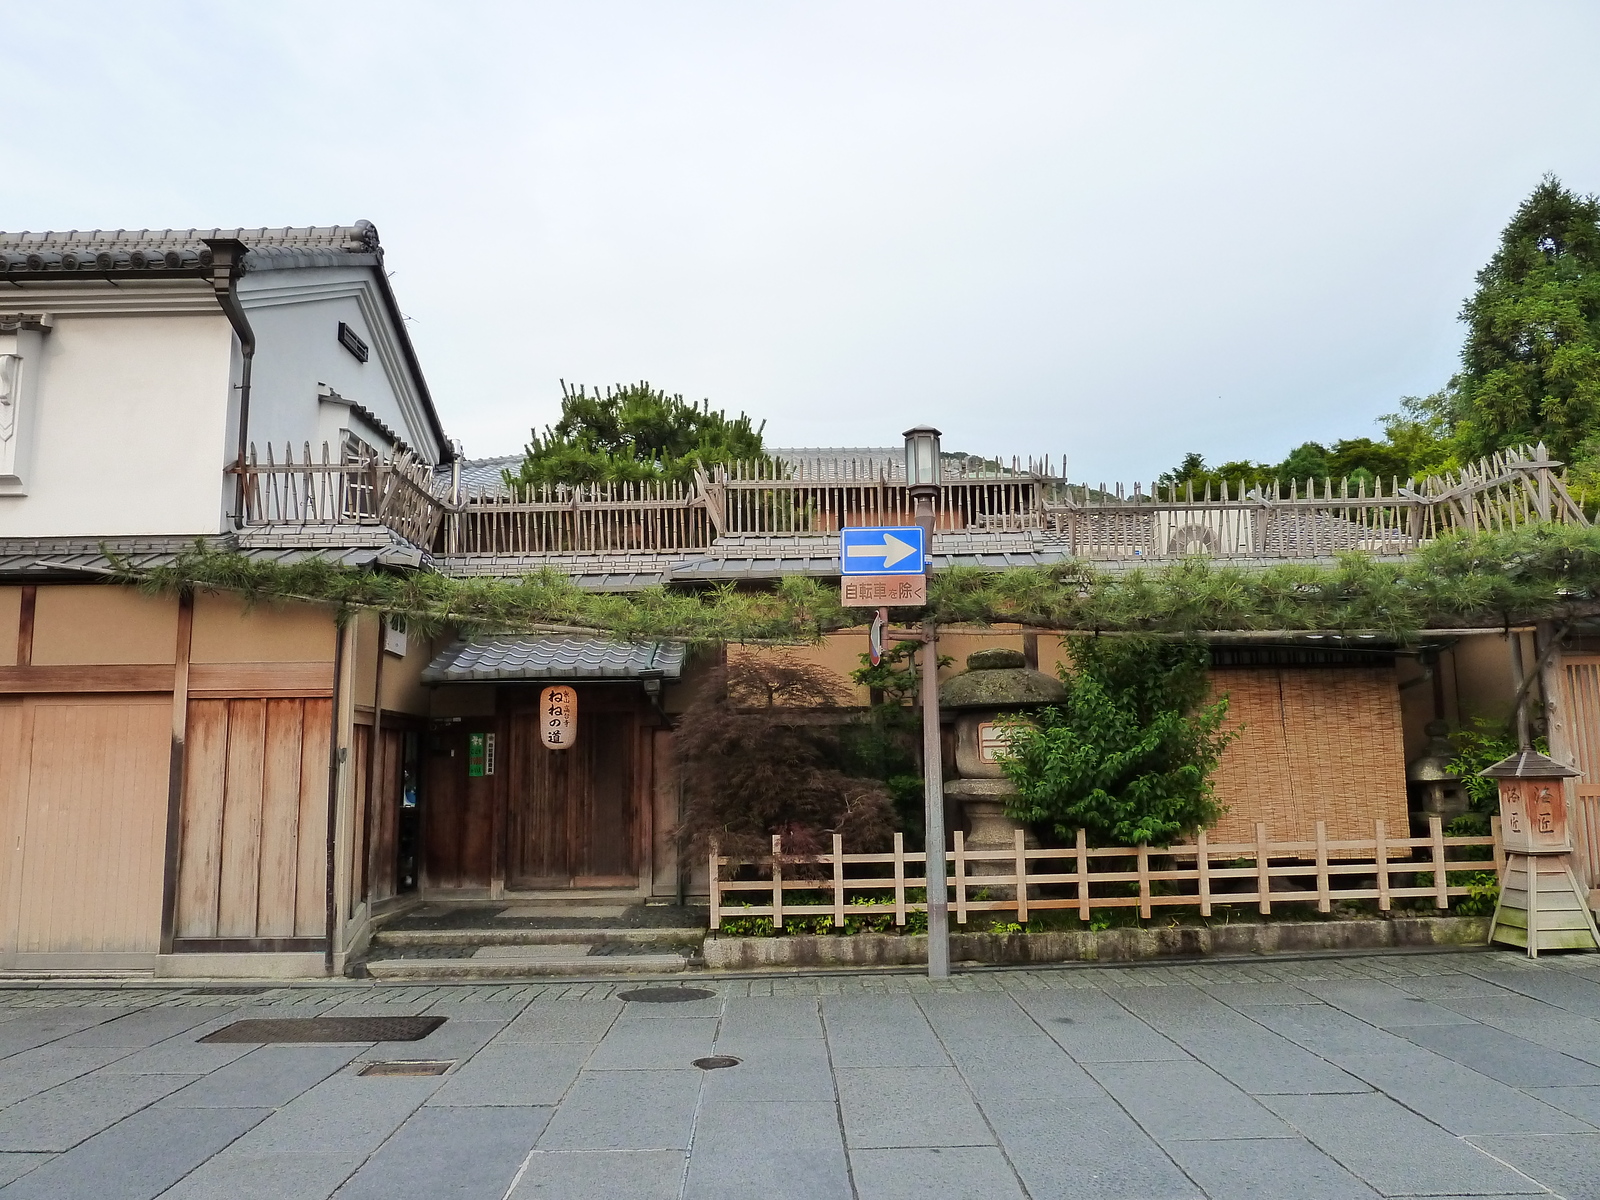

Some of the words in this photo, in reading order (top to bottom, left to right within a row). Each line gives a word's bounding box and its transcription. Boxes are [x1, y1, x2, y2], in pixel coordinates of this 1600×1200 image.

[845, 582, 922, 600] 自転車を除く
[547, 690, 563, 744] ねねの道
[1507, 786, 1521, 833] 洛匠
